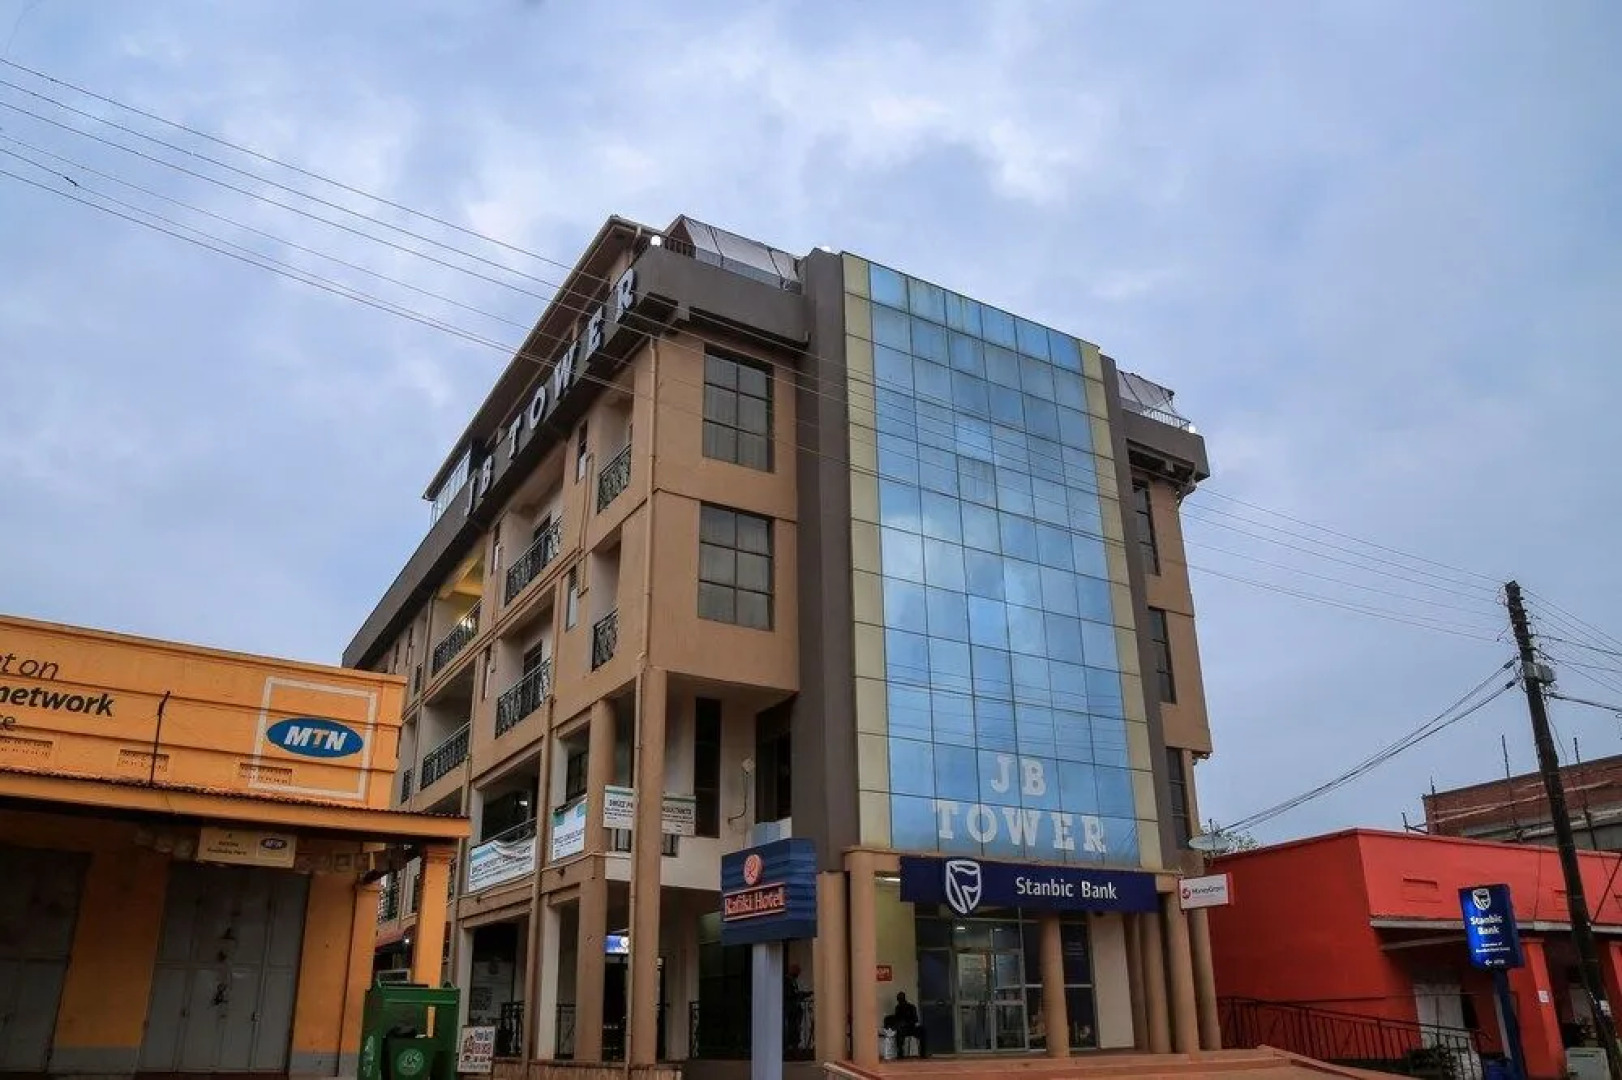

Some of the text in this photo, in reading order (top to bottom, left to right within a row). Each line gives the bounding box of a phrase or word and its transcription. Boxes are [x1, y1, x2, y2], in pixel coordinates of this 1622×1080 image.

[508, 268, 636, 460] TOWER
[19, 660, 59, 680] on
[283, 726, 347, 751] MTN
[991, 752, 1047, 796] JB
[933, 800, 1107, 853] TOWER
[755, 886, 785, 910] Hotel
[1015, 876, 1118, 900] Stanbic Bank
[1470, 914, 1503, 925] Stanbic
[1477, 925, 1500, 935] Bank
